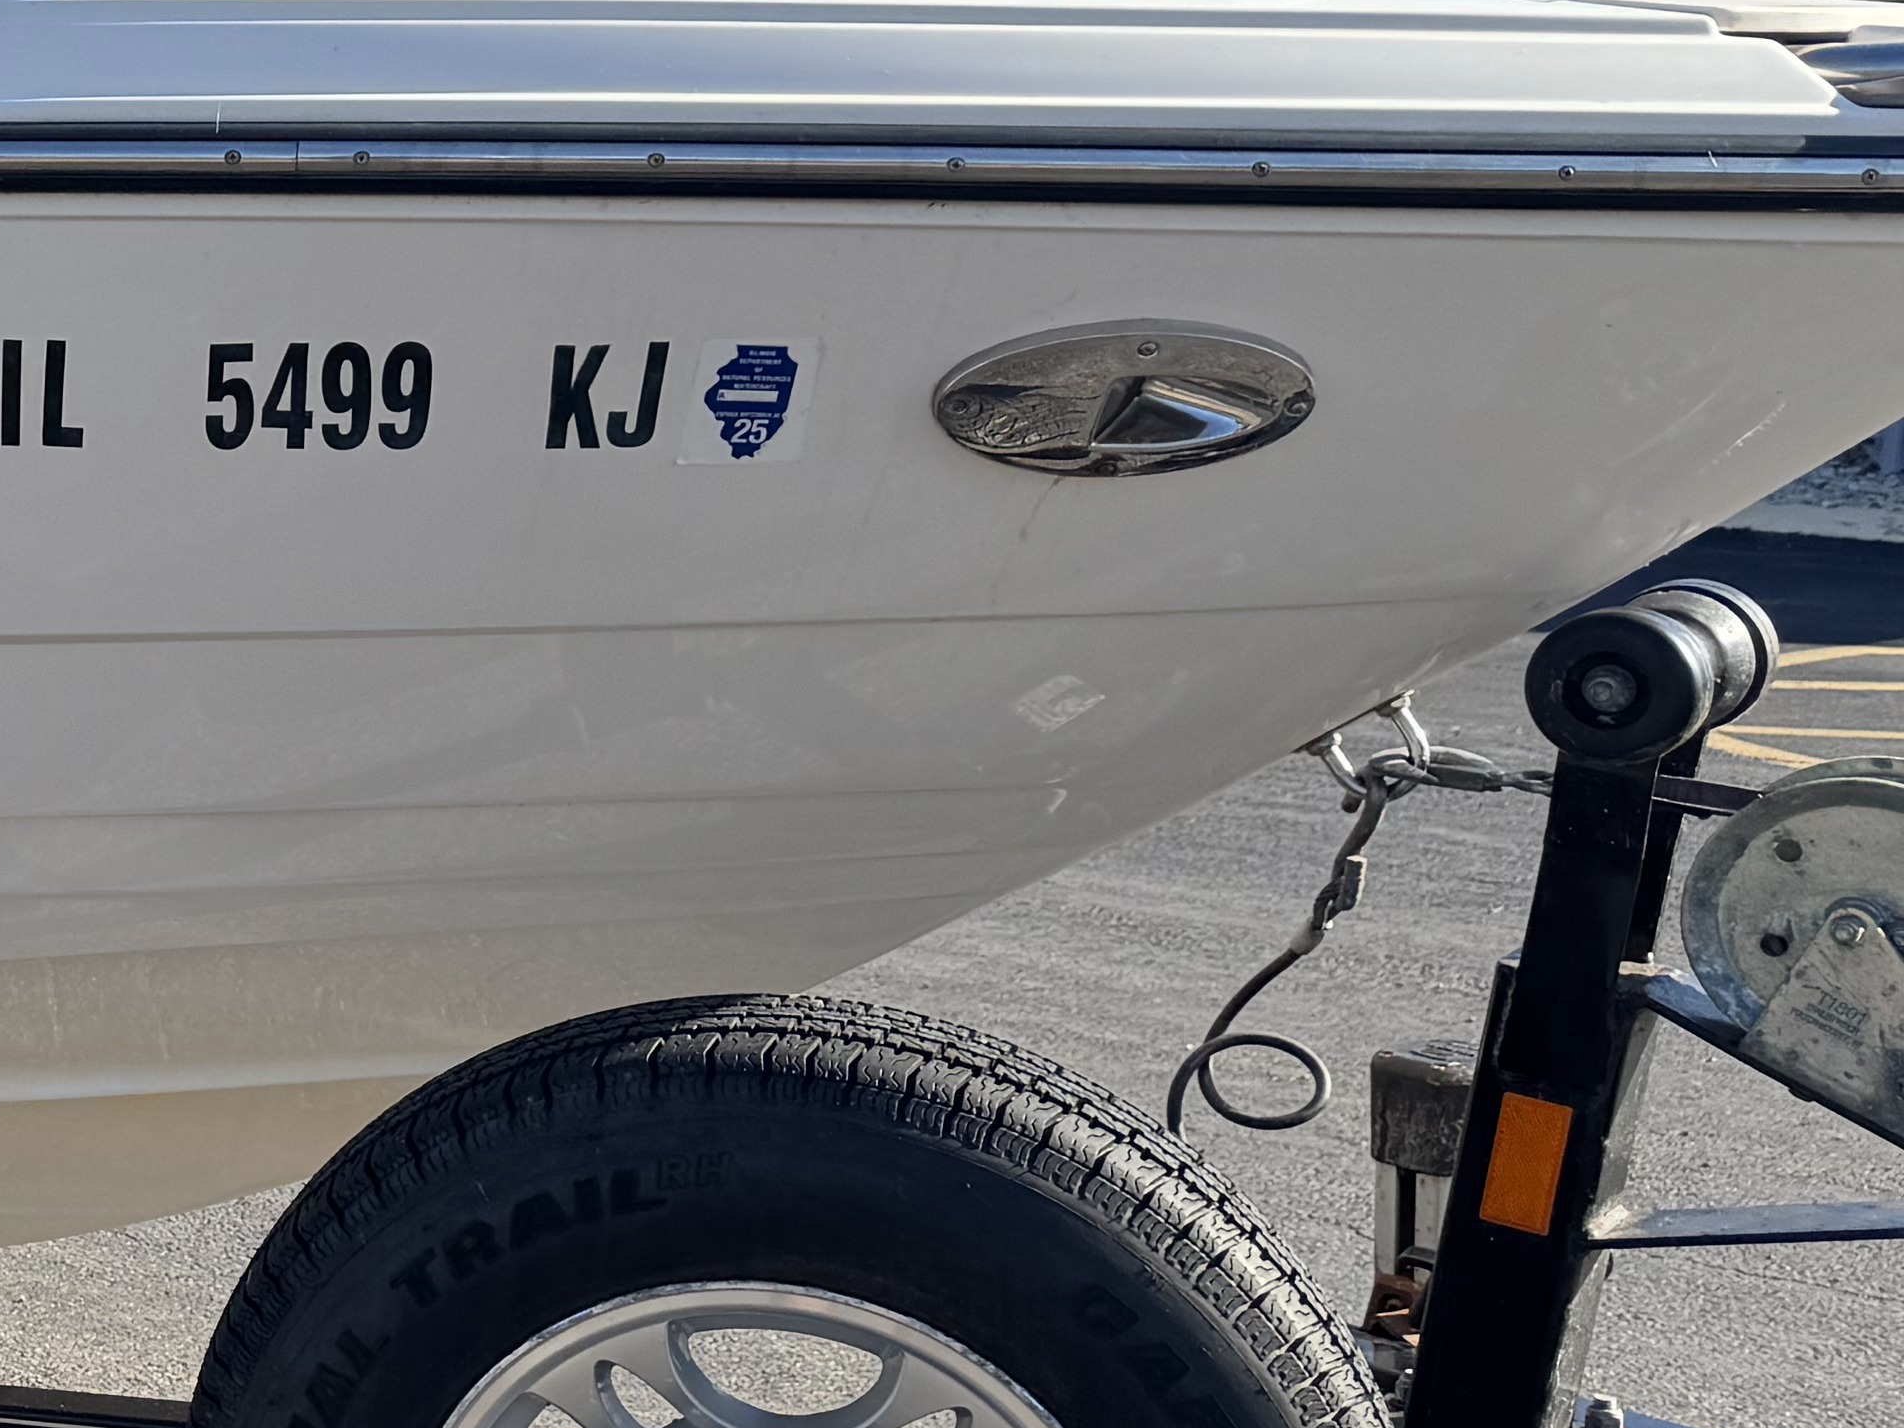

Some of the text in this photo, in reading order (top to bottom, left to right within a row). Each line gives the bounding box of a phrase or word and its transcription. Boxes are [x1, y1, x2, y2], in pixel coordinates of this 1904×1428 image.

[1, 339, 670, 450] IL 5499 KJ
[730, 418, 769, 444] 25
[389, 1167, 668, 1310] TRAIL
